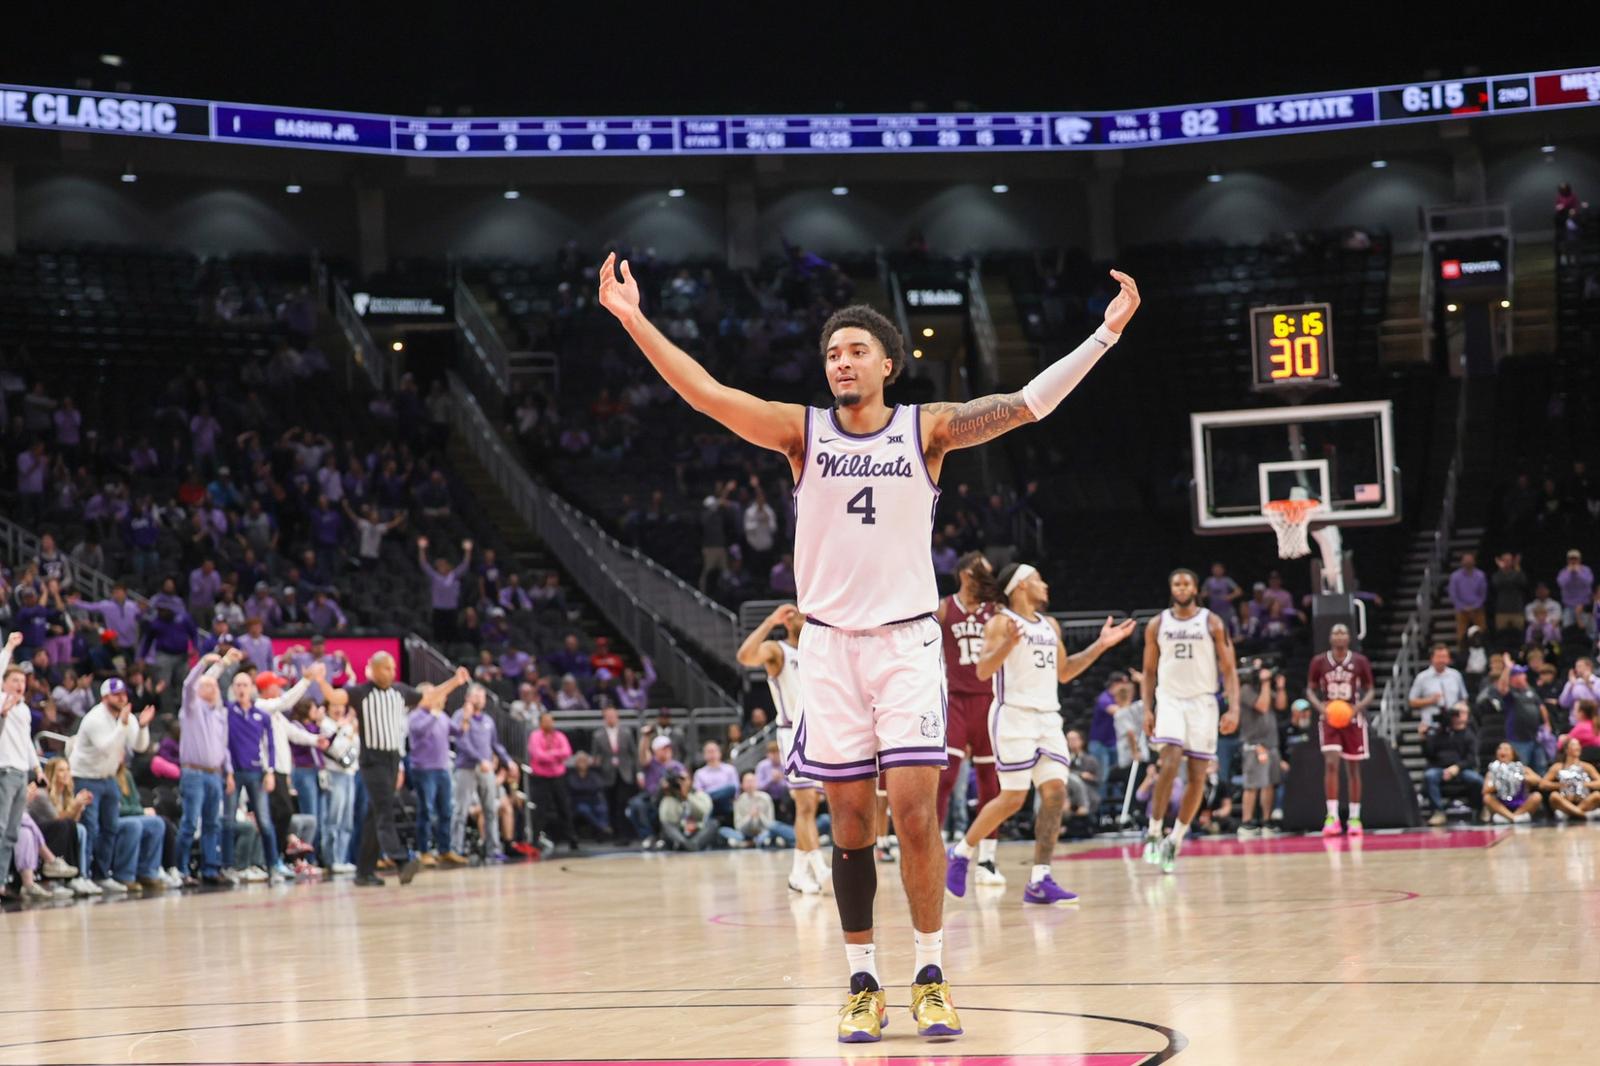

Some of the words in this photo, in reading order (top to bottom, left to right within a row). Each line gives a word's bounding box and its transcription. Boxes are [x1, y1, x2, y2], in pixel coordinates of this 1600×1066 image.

[0, 90, 28, 122] E
[32, 93, 177, 134] CLASSIC
[1256, 96, 1353, 126] K-STATE
[1402, 83, 1464, 112] 6:15
[1181, 108, 1220, 137] 82
[1273, 312, 1323, 338] 6:15
[1269, 336, 1319, 378] 30
[816, 452, 913, 478] Wildcats
[847, 486, 876, 525] 4
[1033, 650, 1056, 669] 34
[1175, 643, 1193, 659] 21
